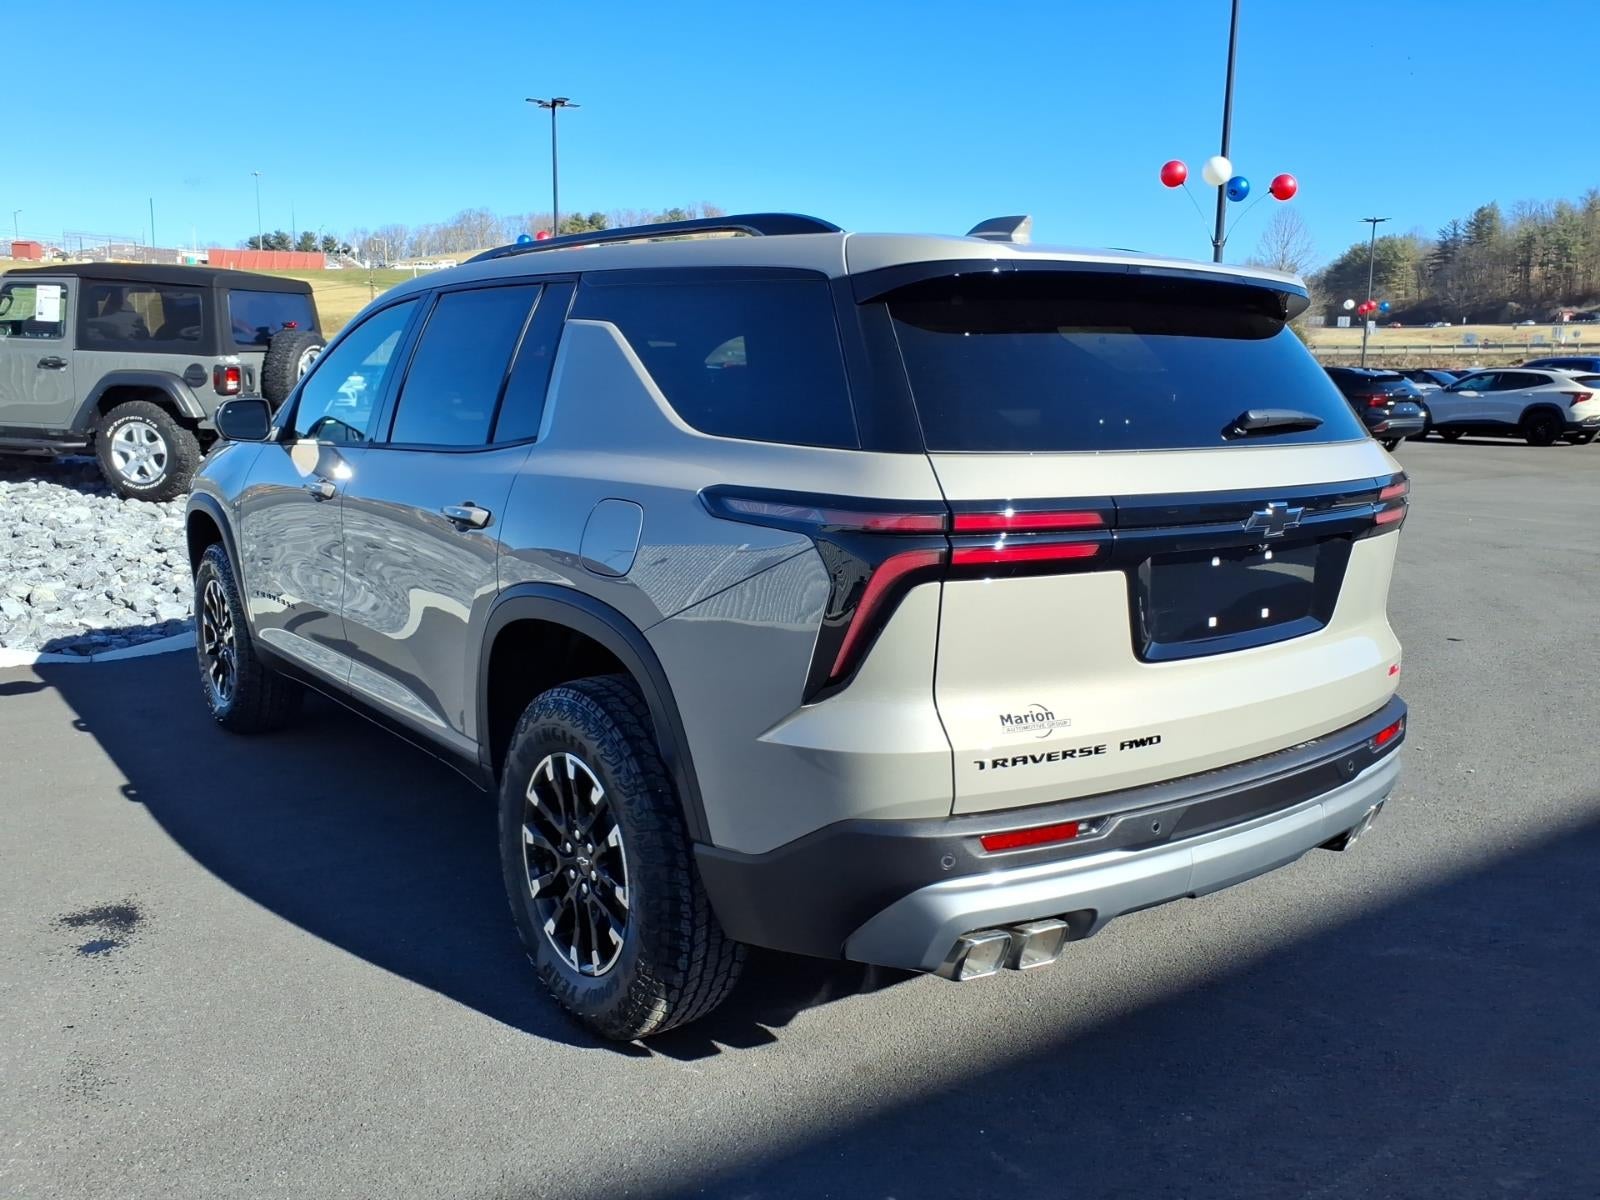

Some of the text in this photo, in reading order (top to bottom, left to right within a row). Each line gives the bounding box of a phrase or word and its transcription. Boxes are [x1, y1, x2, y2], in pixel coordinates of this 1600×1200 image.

[999, 710, 1055, 727] Marion
[1006, 720, 1069, 733] AUTOMOTIVE GROUP
[973, 735, 1162, 771] TRAVERSE AWD
